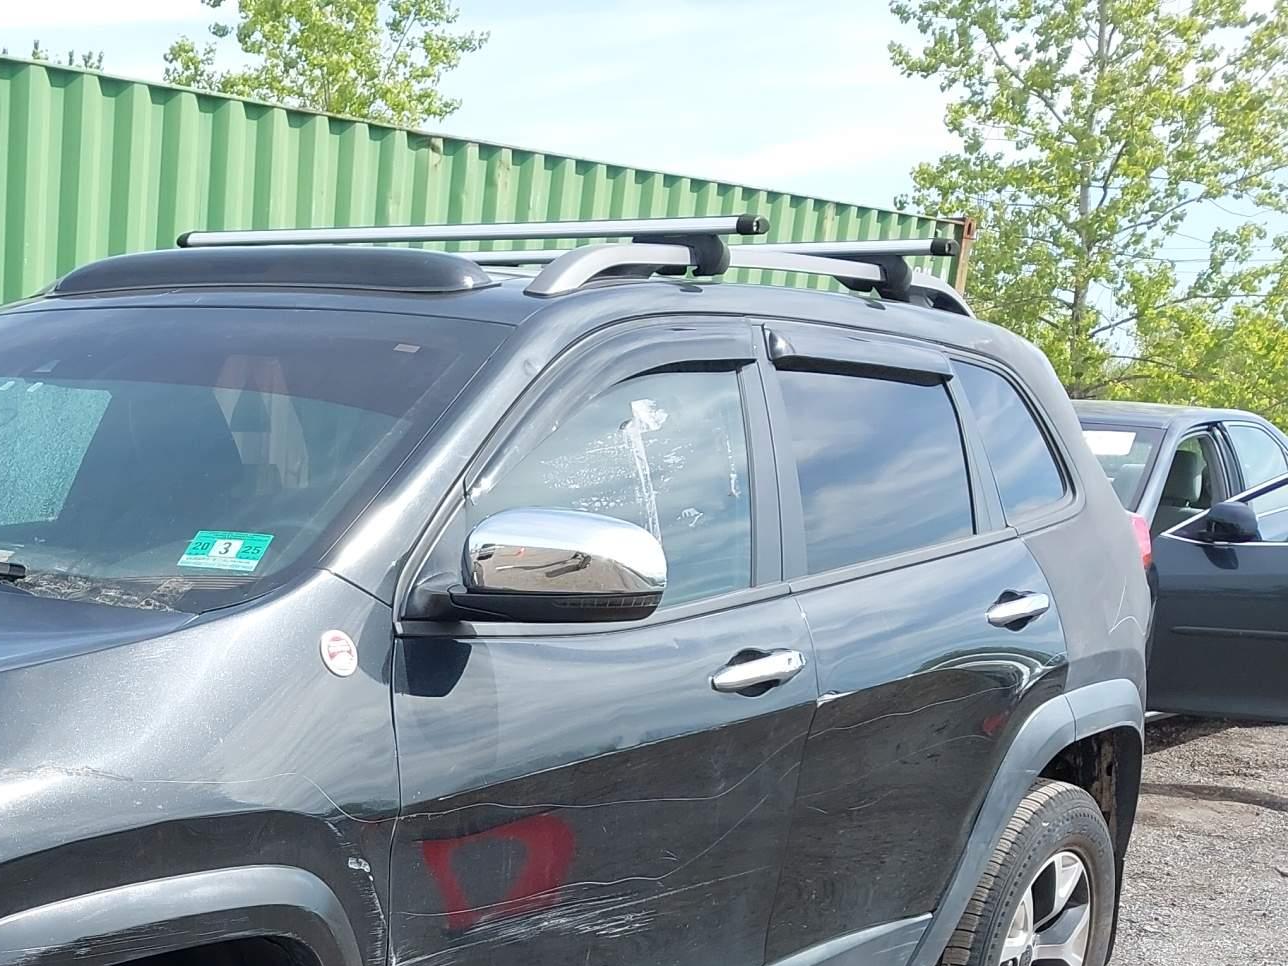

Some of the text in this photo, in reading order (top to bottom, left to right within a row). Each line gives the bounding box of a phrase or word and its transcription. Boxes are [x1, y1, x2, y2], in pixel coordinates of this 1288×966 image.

[192, 541, 262, 555] 20 3 25
